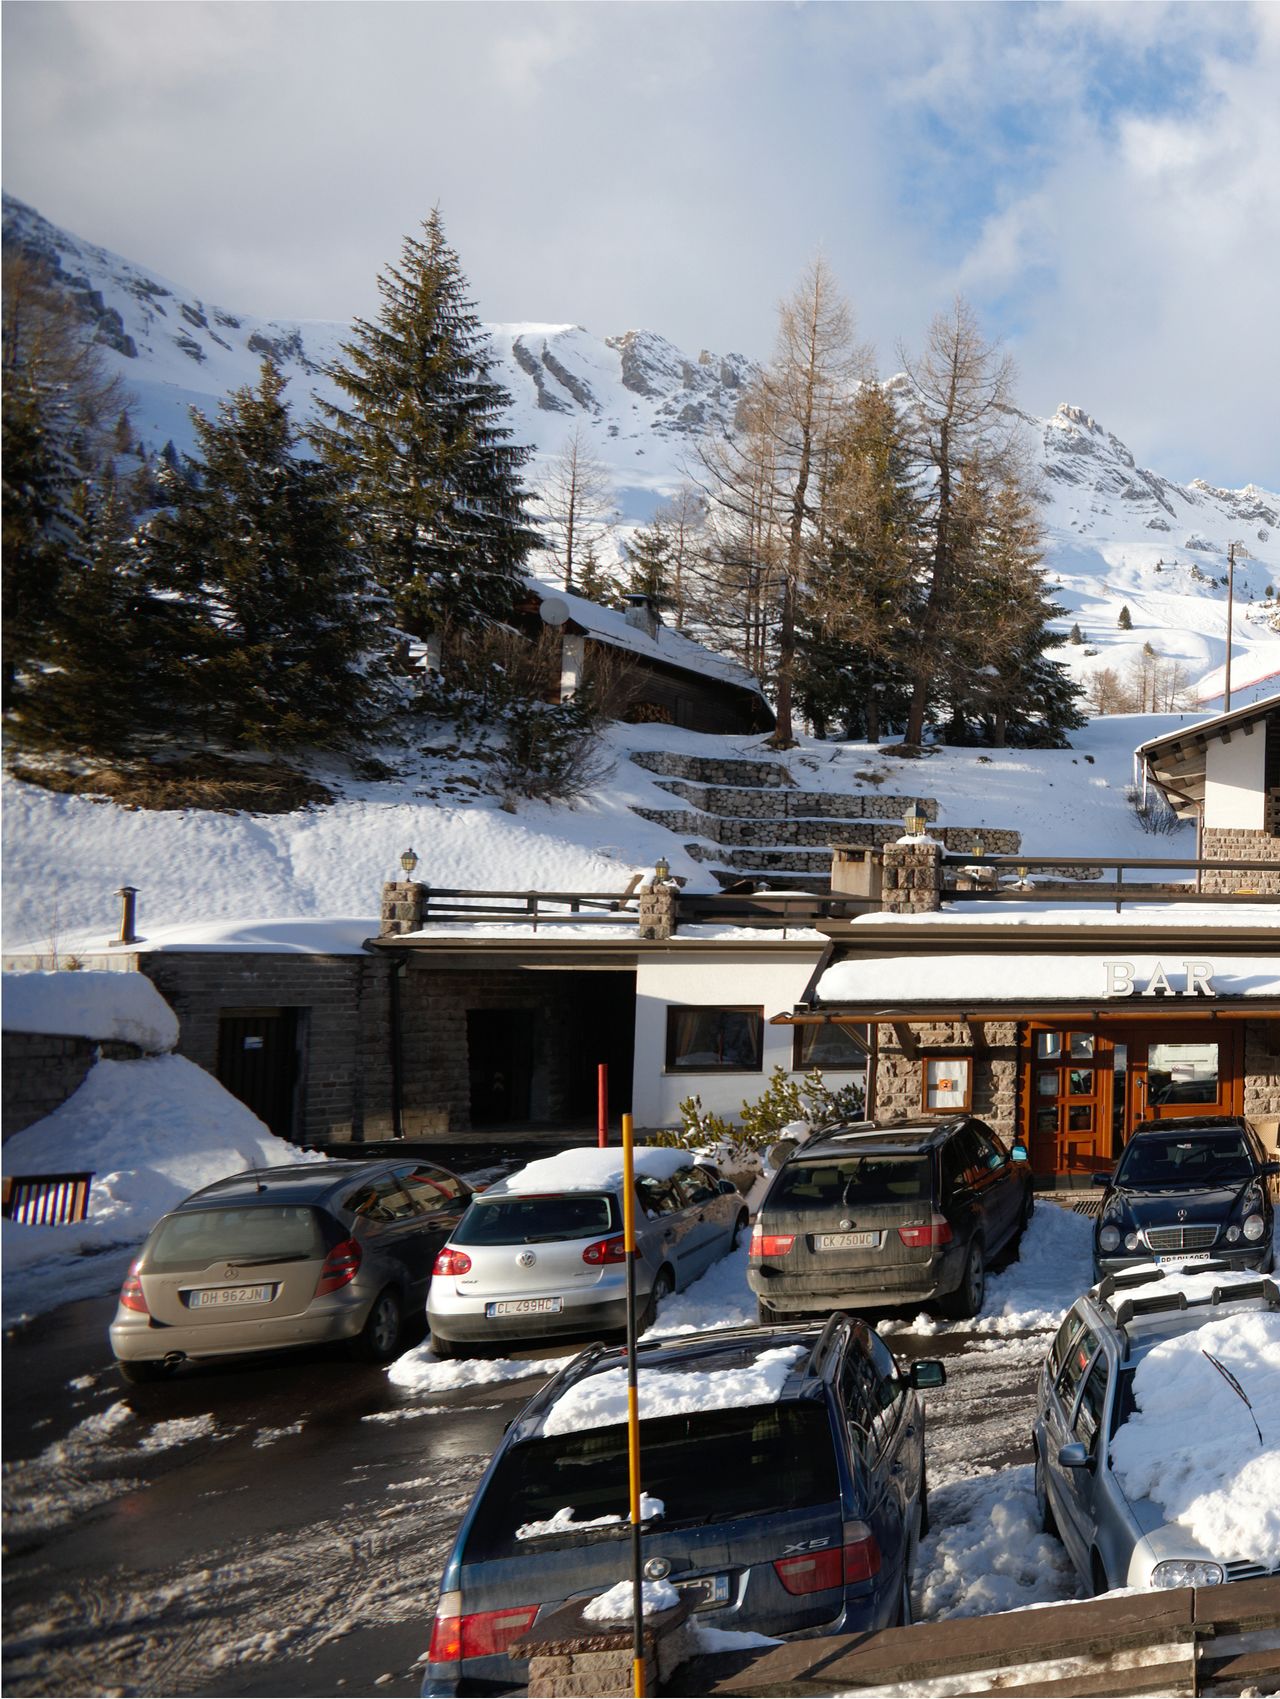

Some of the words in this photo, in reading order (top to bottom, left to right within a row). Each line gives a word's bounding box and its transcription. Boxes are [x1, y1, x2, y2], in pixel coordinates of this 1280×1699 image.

[1102, 961, 1216, 997] BAR
[822, 1236, 835, 1248] CK
[201, 1291, 217, 1304] DH
[222, 1288, 263, 1301] 962JN
[497, 1303, 510, 1314] CL
[515, 1300, 553, 1313] 499HC
[783, 1537, 830, 1554] X5
